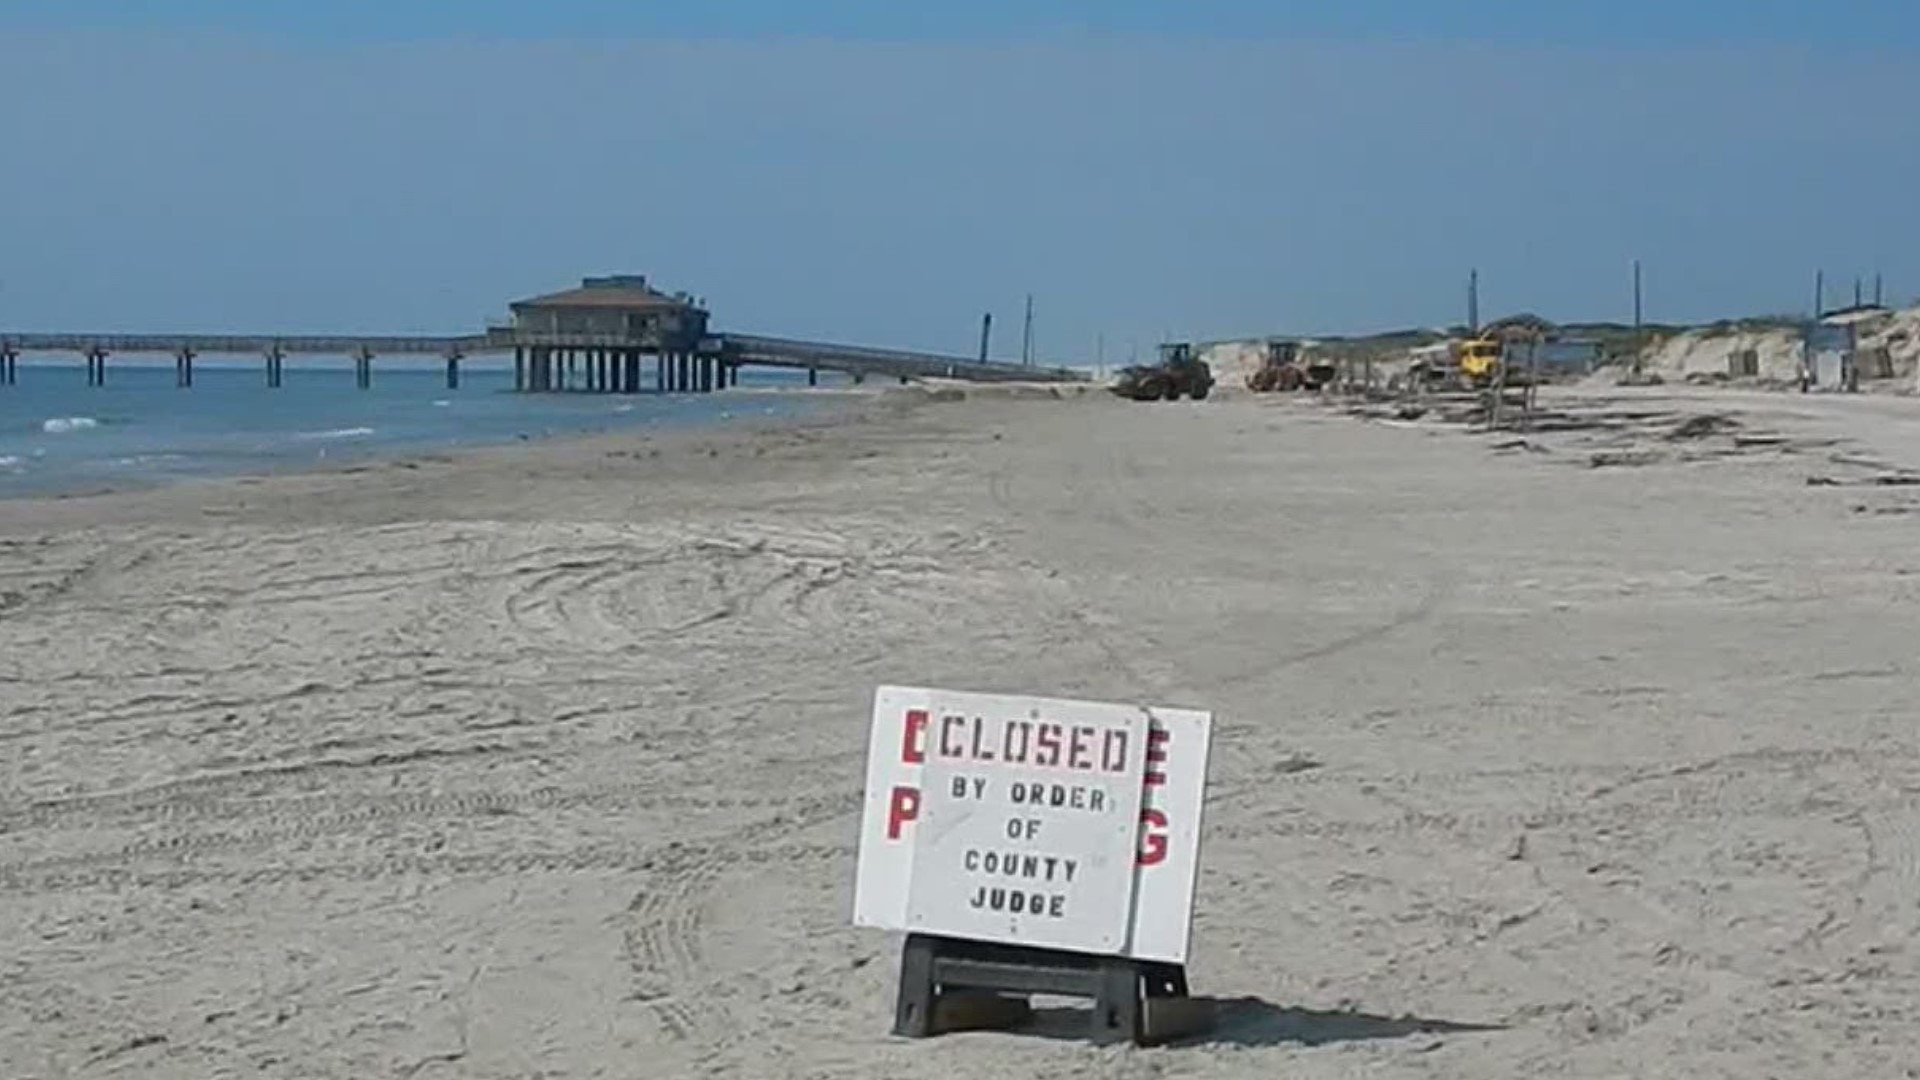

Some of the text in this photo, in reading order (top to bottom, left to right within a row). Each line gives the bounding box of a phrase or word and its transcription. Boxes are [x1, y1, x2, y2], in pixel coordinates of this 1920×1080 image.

[940, 715, 1127, 772] CLOSED
[951, 776, 1105, 812] BY ORDER
[1007, 817, 1042, 840] OF
[965, 849, 1077, 882] COUNTY
[970, 886, 1066, 918] JUDGE
